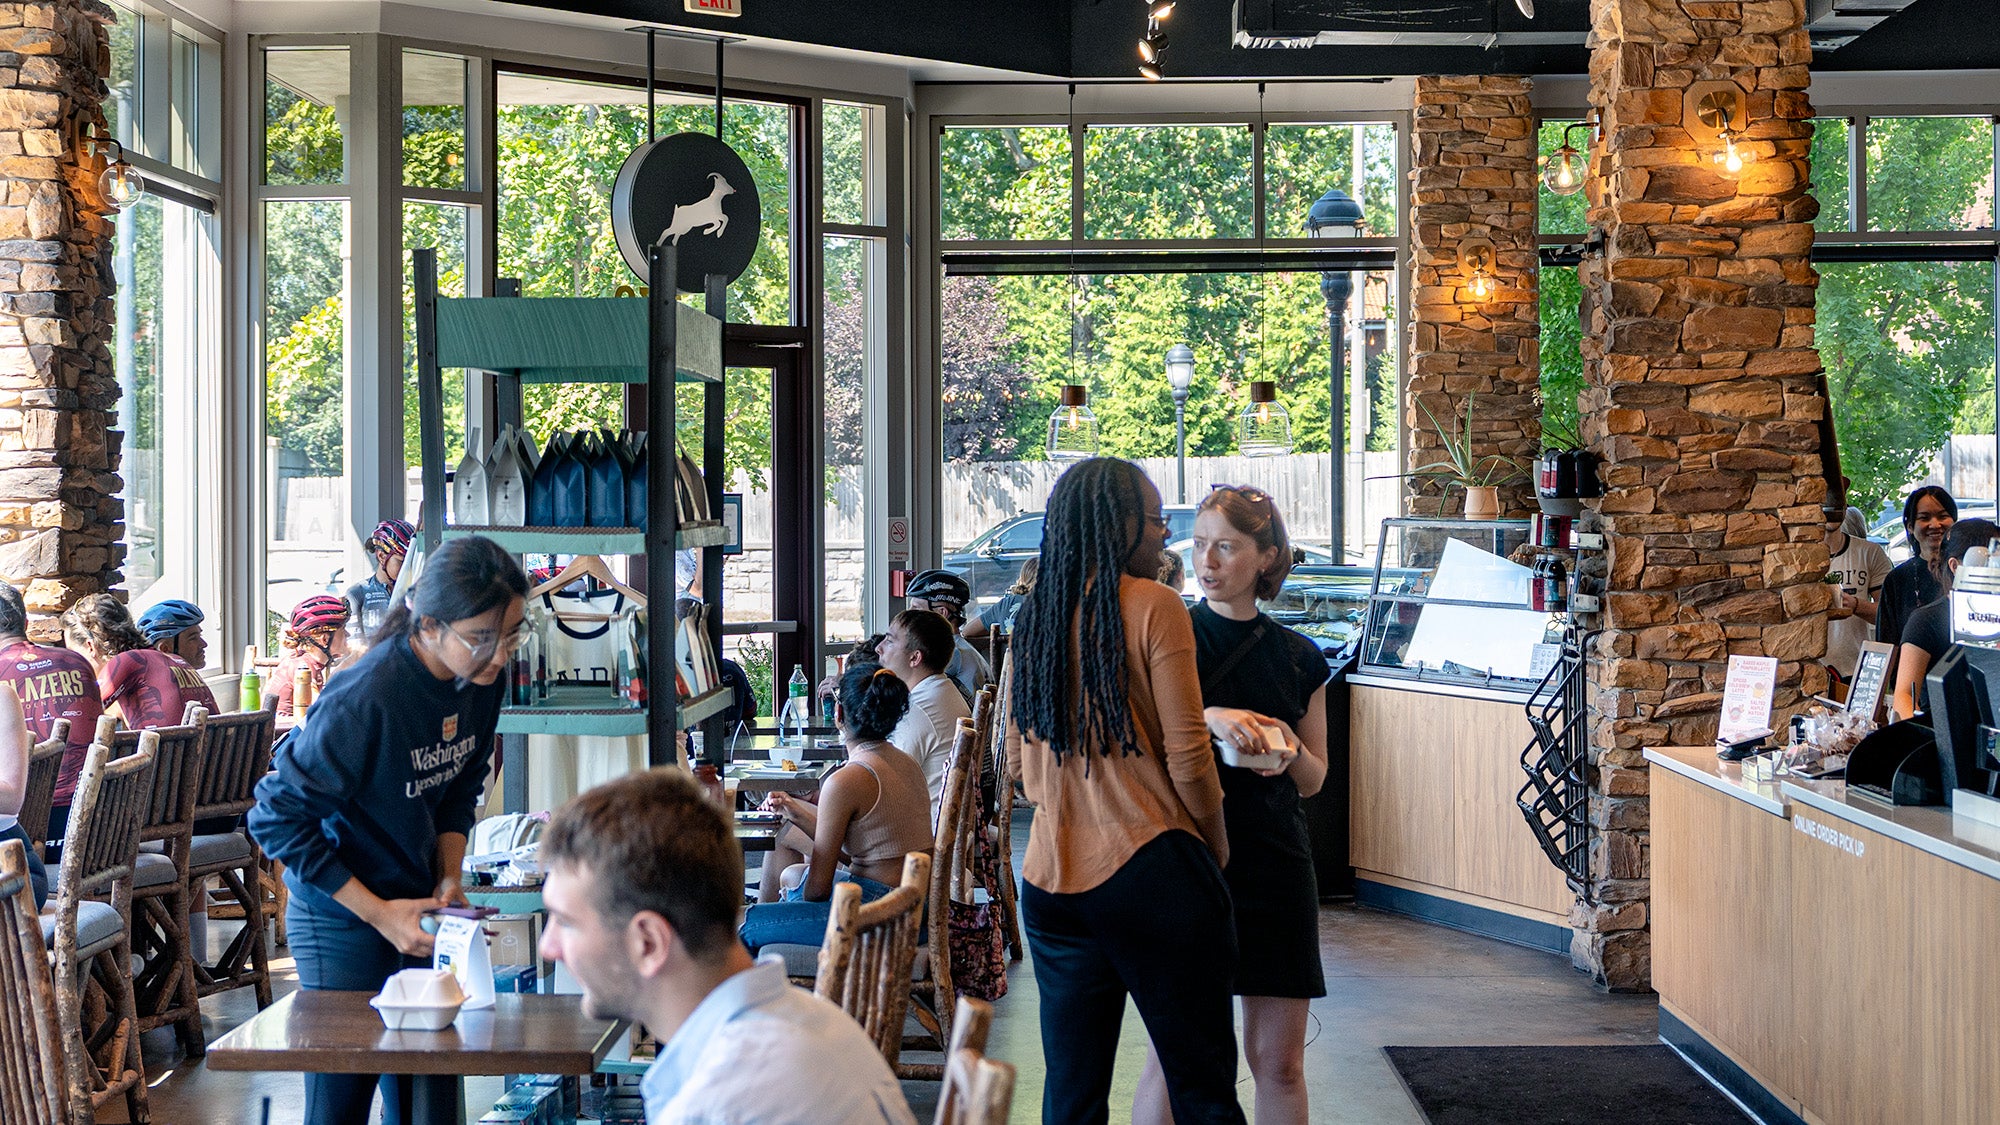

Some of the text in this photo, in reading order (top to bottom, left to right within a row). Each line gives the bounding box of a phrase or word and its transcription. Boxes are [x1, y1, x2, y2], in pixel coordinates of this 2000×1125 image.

[1794, 814, 1865, 858] ONLINE ORDER PICK UP
